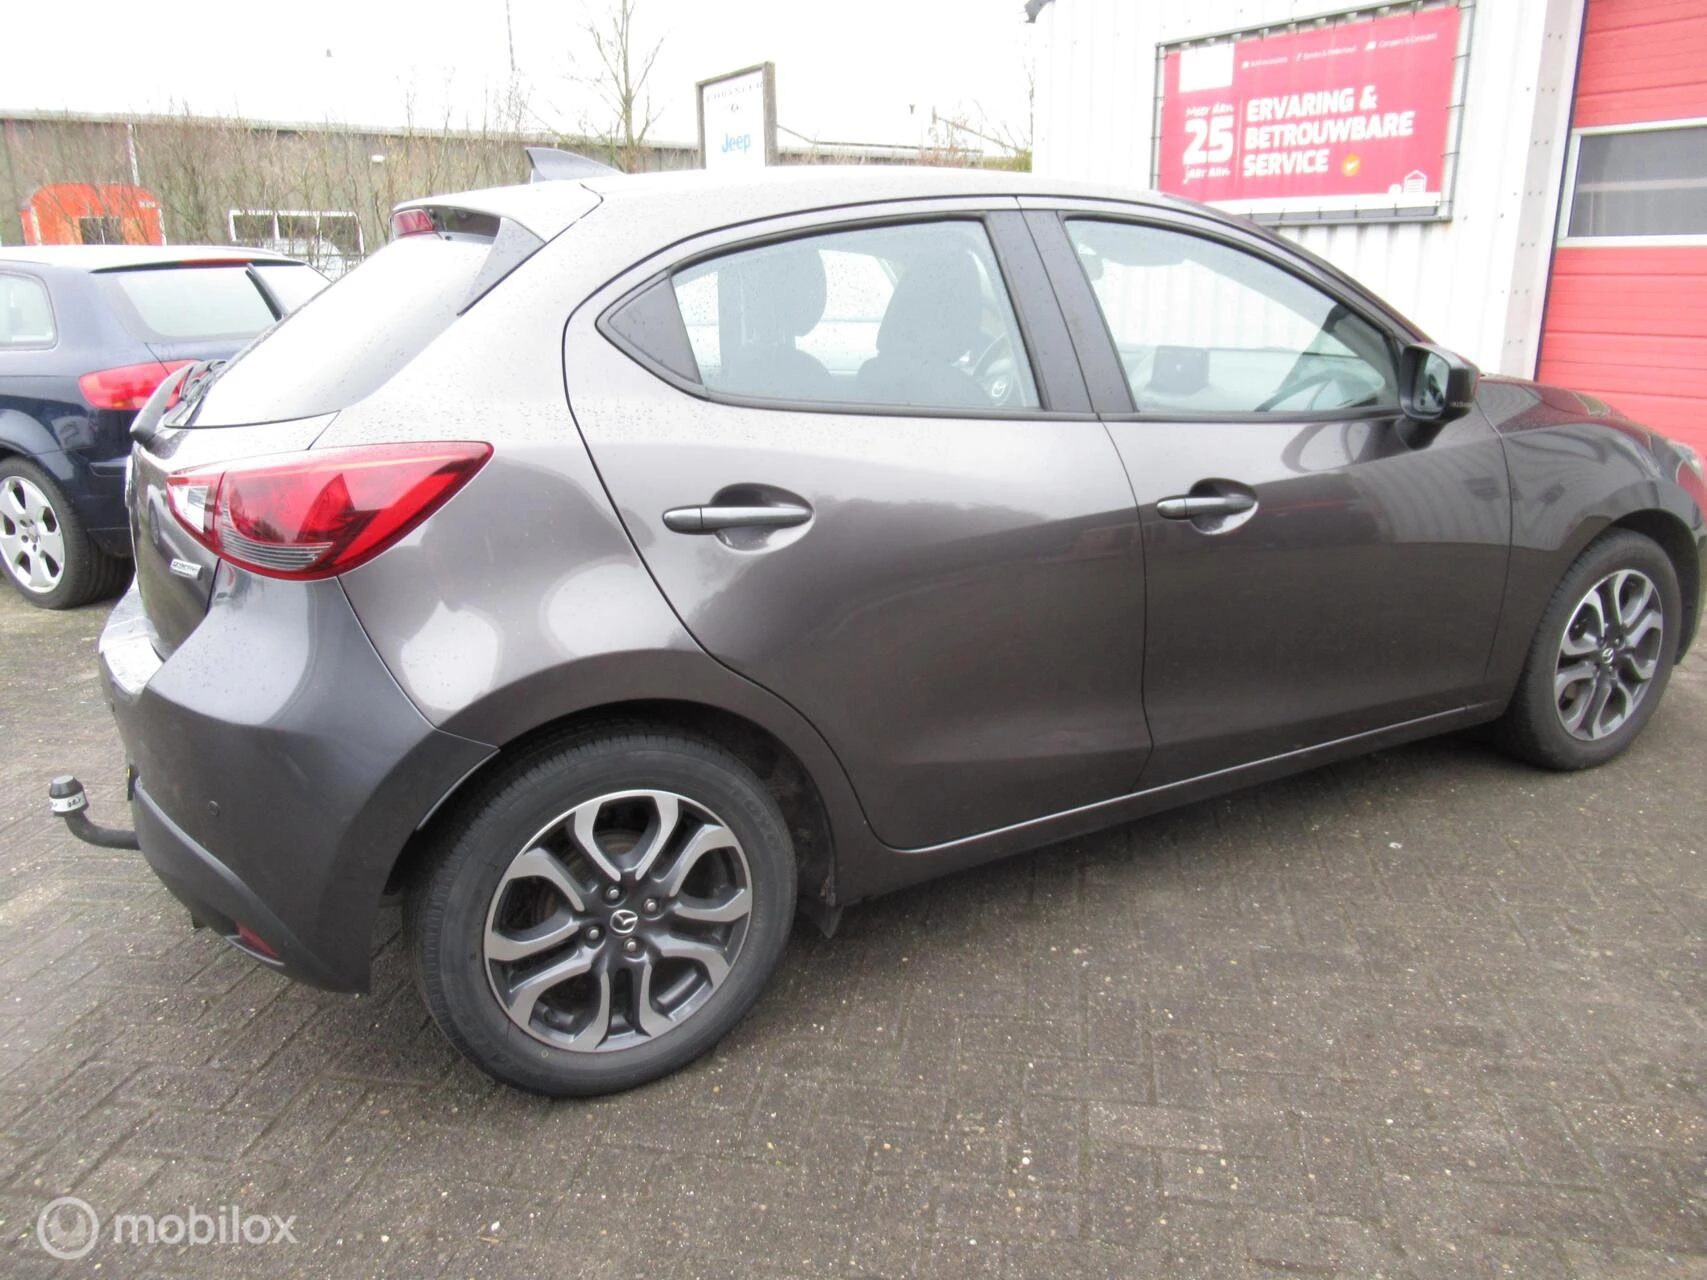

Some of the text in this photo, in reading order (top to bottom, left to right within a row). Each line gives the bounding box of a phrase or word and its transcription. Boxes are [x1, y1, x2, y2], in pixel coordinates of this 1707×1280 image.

[1247, 84, 1378, 122] ERVARING &
[722, 132, 751, 154] Jeep
[1183, 115, 1234, 165] 25
[1244, 111, 1416, 150] BETROUWBARE
[1243, 149, 1330, 177] SERVICE
